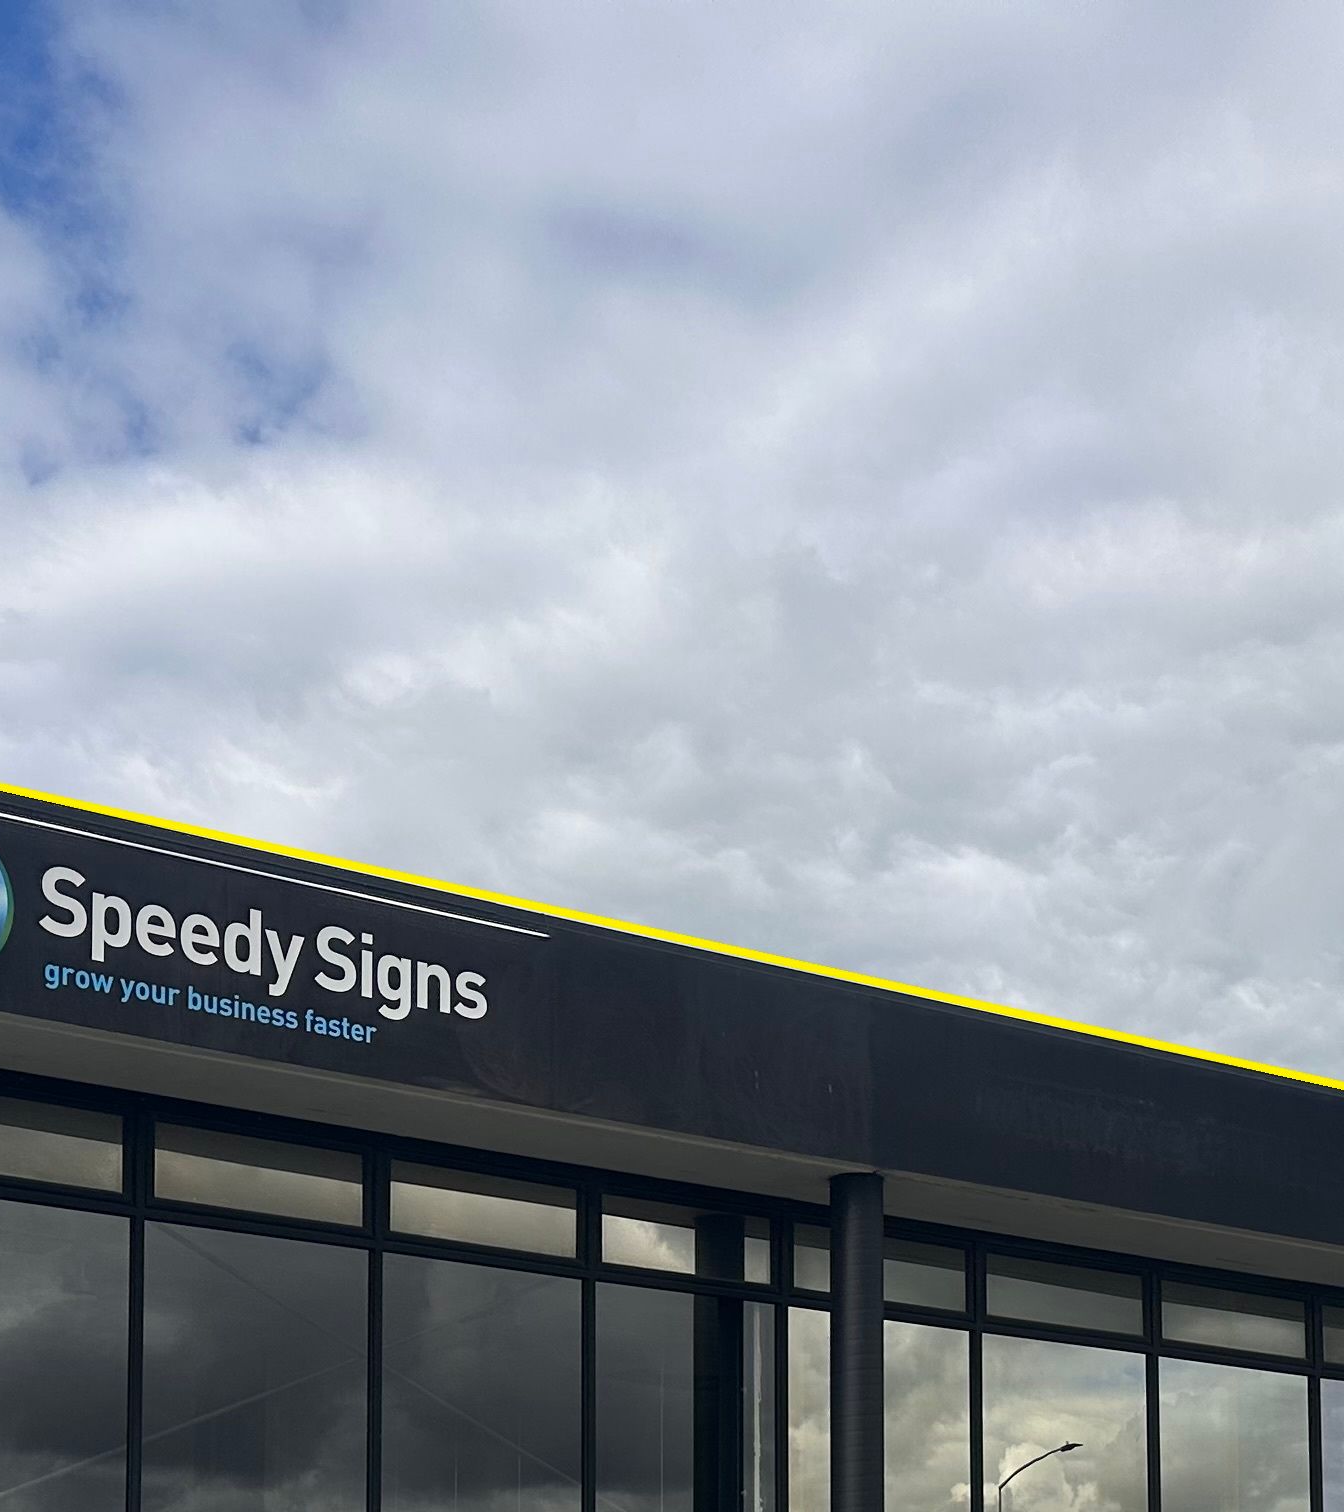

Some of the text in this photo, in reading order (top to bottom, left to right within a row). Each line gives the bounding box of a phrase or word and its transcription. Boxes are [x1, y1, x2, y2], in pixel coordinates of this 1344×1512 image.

[38, 866, 489, 1021] Speedy Signs
[43, 961, 377, 1044] grow your business faster
